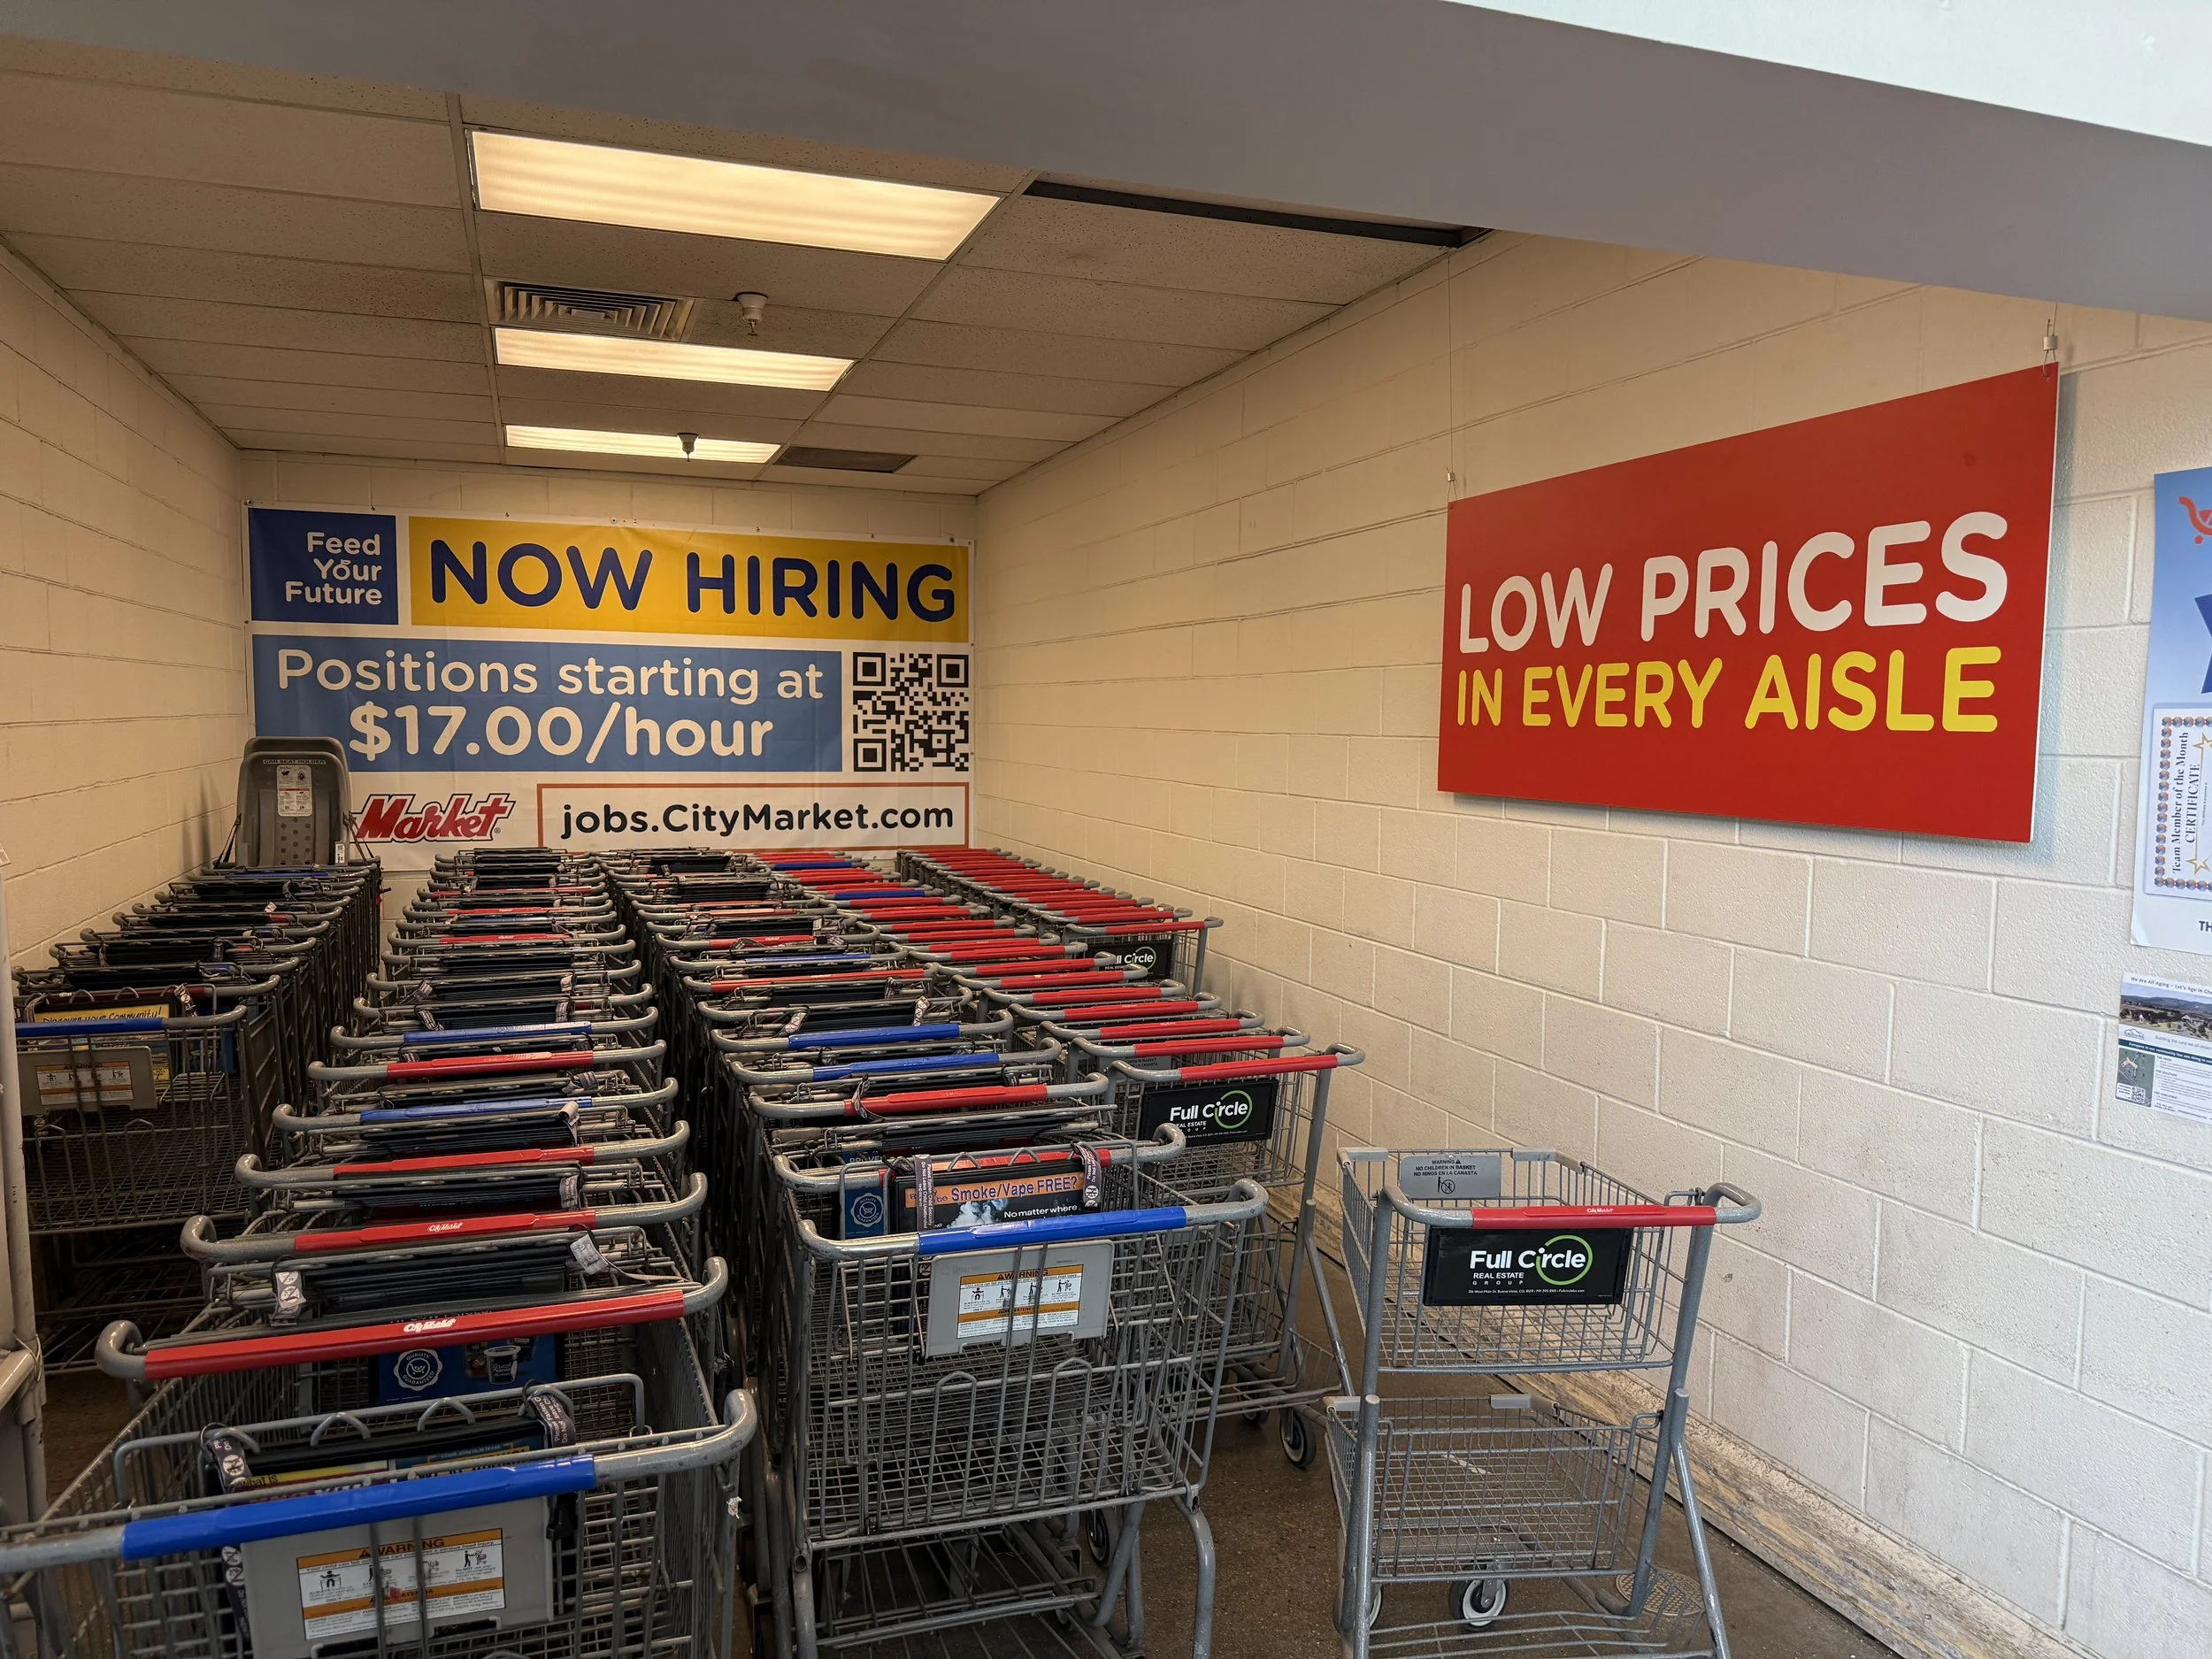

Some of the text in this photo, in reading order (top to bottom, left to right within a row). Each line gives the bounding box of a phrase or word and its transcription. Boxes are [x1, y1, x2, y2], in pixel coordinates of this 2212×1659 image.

[306, 532, 381, 557] Feed
[313, 557, 382, 582] Your
[430, 539, 956, 623] NOW HIRING
[284, 580, 383, 605] Future
[1459, 511, 2008, 654] LOW PRICES
[277, 649, 824, 706] Positions starting at
[1457, 646, 2001, 733] IN EVERY AISLE
[349, 700, 774, 764] $17.00/hour
[2171, 732, 2189, 874] Team Member of the Month
[2185, 764, 2200, 843] CERTIFICATE
[356, 795, 514, 841] Market
[560, 802, 955, 840] jobs.CityMarket.com
[1124, 952, 1154, 964] Circle
[1169, 1100, 1248, 1122] Full Circle
[951, 1182, 1034, 1202] Smoke/Vape
[1037, 1176, 1078, 1193] FREE?
[1018, 1208, 1049, 1217] matter
[1049, 1204, 1078, 1213] where
[1470, 1247, 1586, 1269] Full Circle
[405, 1352, 431, 1361] QUALITY
[402, 1371, 435, 1386] GUARANTEED
[557, 1420, 568, 1432] Not
[561, 1431, 569, 1444] Do
[376, 1538, 444, 1555] WARNNG
